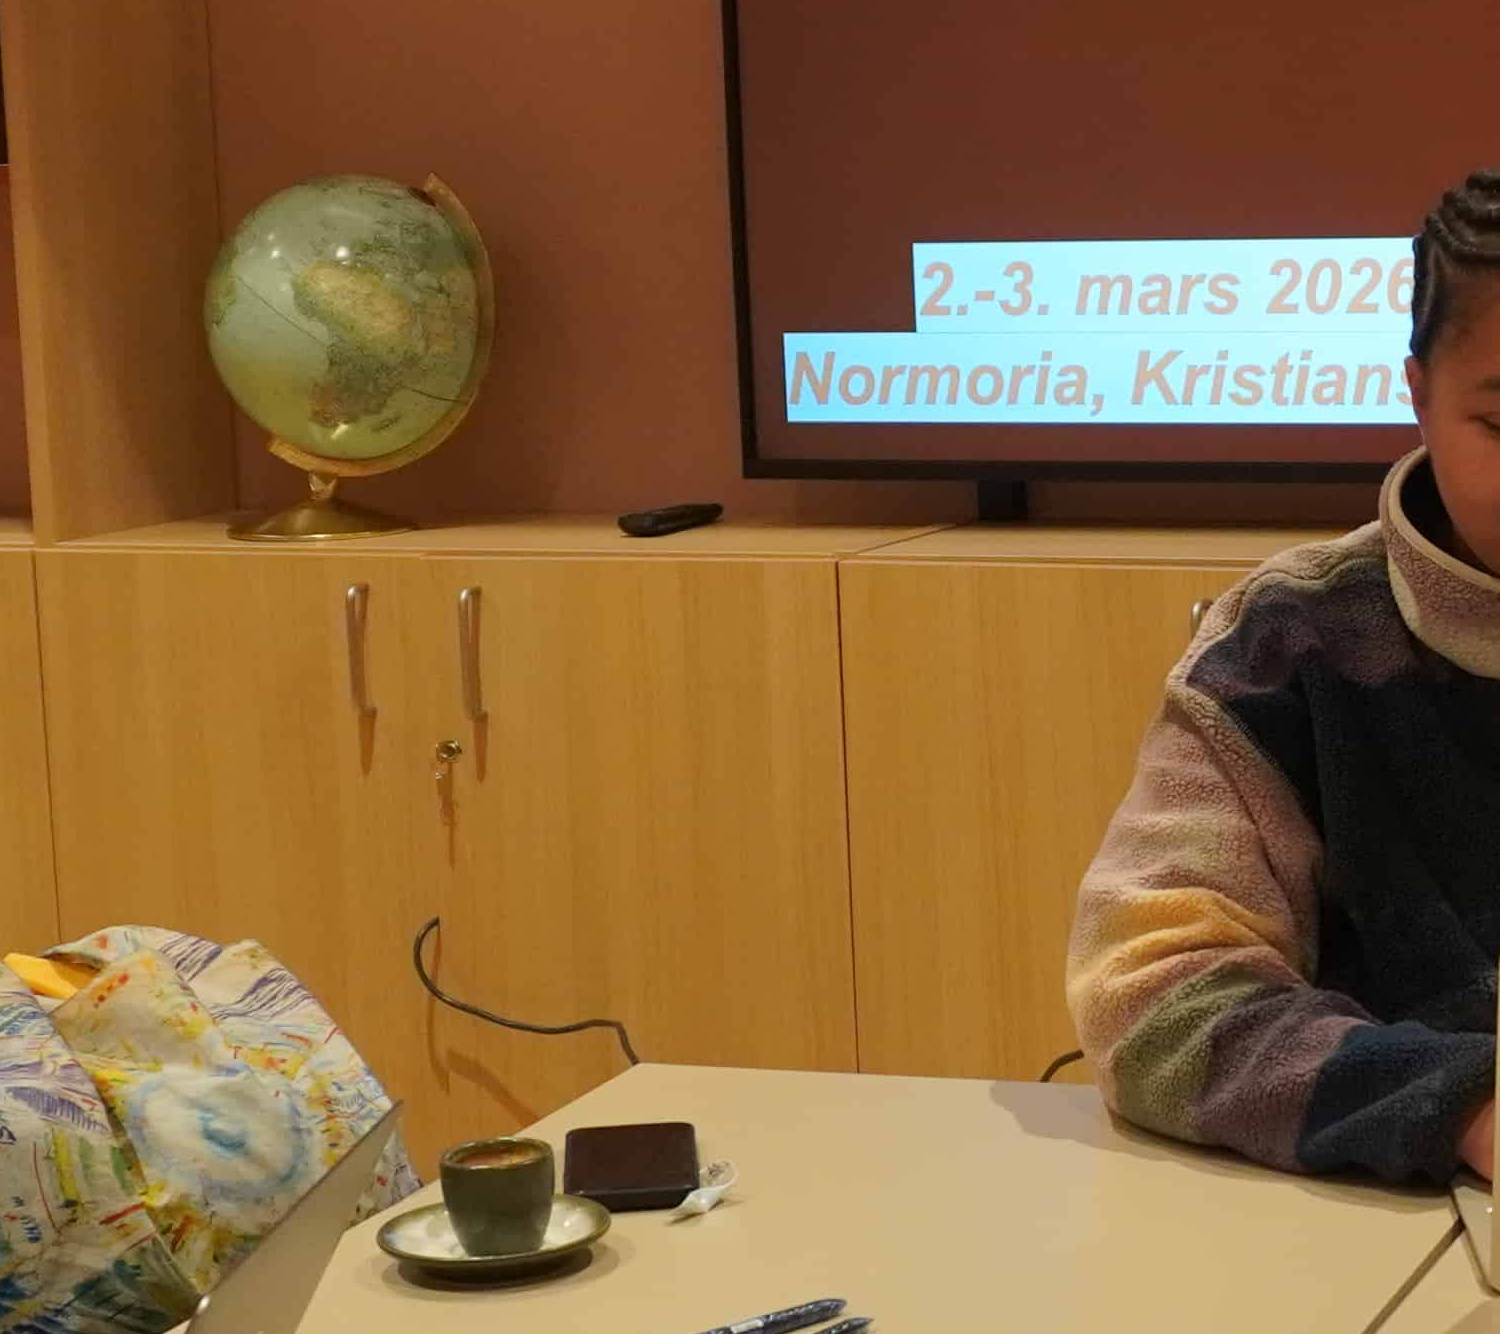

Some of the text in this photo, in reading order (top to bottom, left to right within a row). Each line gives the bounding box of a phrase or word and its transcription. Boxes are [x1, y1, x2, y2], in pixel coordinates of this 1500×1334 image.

[920, 258, 1414, 316] 2.-3. mars 2026
[789, 351, 1103, 416] Normoria,
